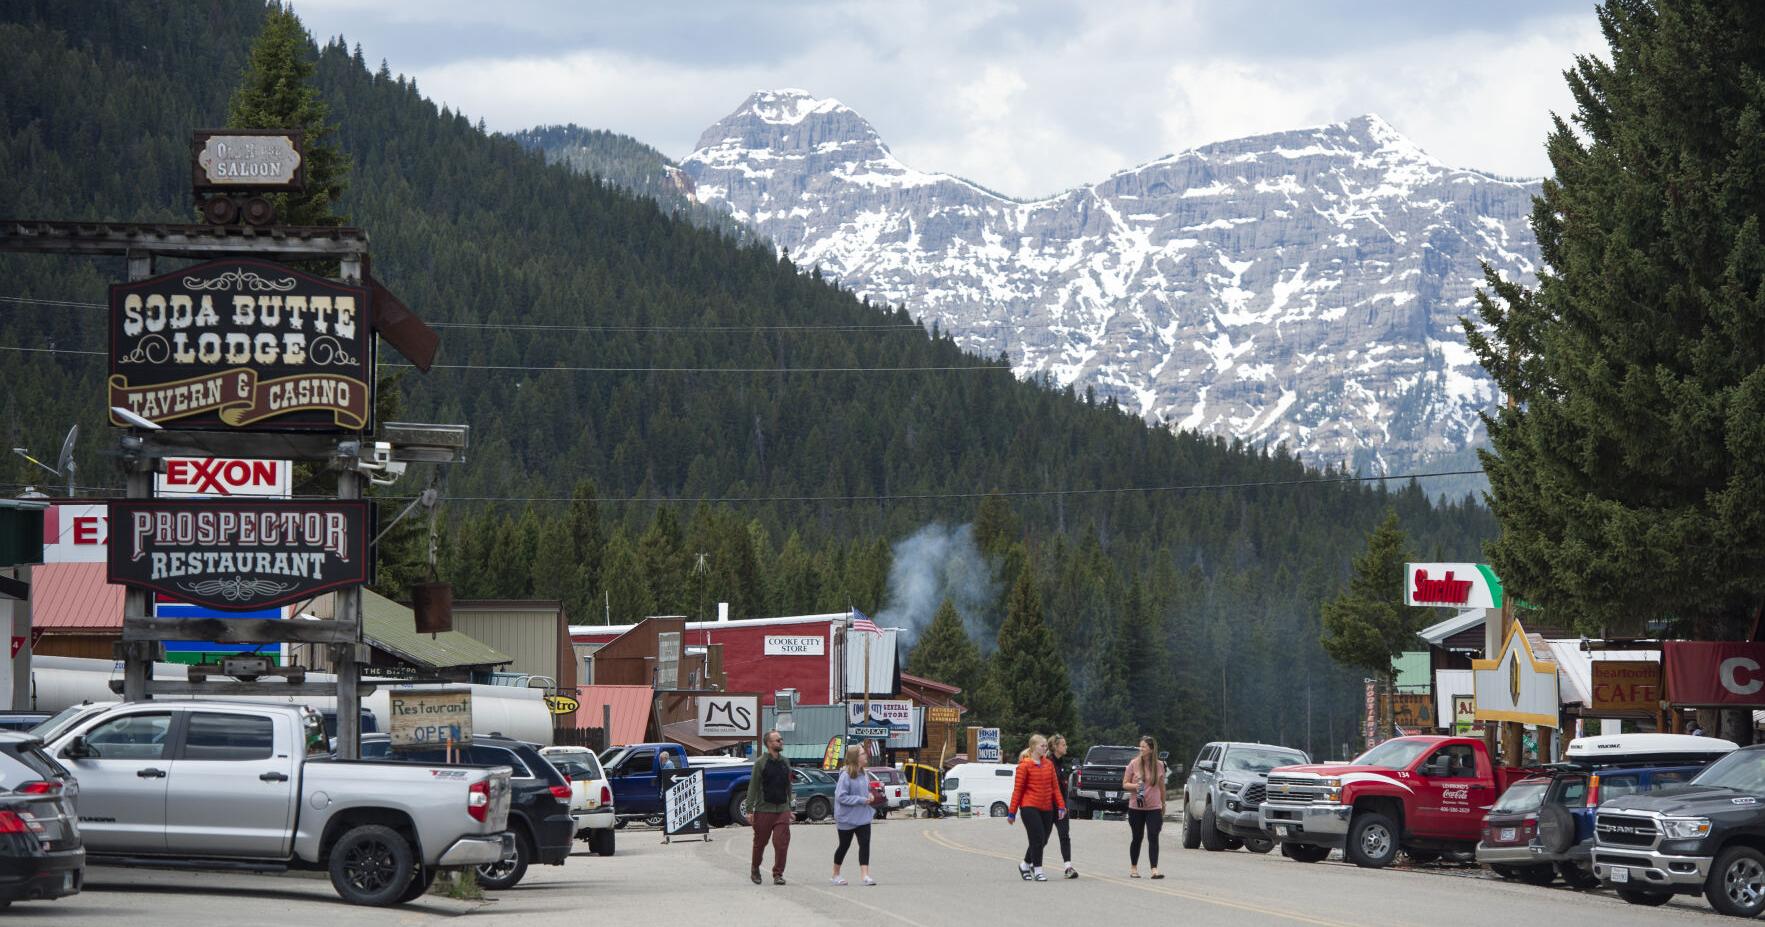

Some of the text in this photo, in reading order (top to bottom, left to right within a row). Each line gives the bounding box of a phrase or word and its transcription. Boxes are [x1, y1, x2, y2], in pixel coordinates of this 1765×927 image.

[218, 162, 281, 176] SALOON
[123, 293, 356, 340] SODA BUTTE
[173, 332, 306, 365] LODGE
[128, 373, 351, 418] TAVERN & CASINO
[166, 457, 277, 496] EXXON
[130, 511, 350, 563] PROSPECTOR
[150, 551, 326, 580] RESTAURANT
[1594, 684, 1656, 702] CAFE
[392, 698, 468, 716] Restaurant
[414, 723, 462, 742] OPEN
[978, 749, 998, 759] MOTEL
[672, 774, 696, 796] SNACKS
[674, 786, 696, 806] DRINKS
[672, 806, 700, 830] T-SHIRTS
[674, 804, 686, 818] BAG
[1609, 825, 1634, 834] RAM
